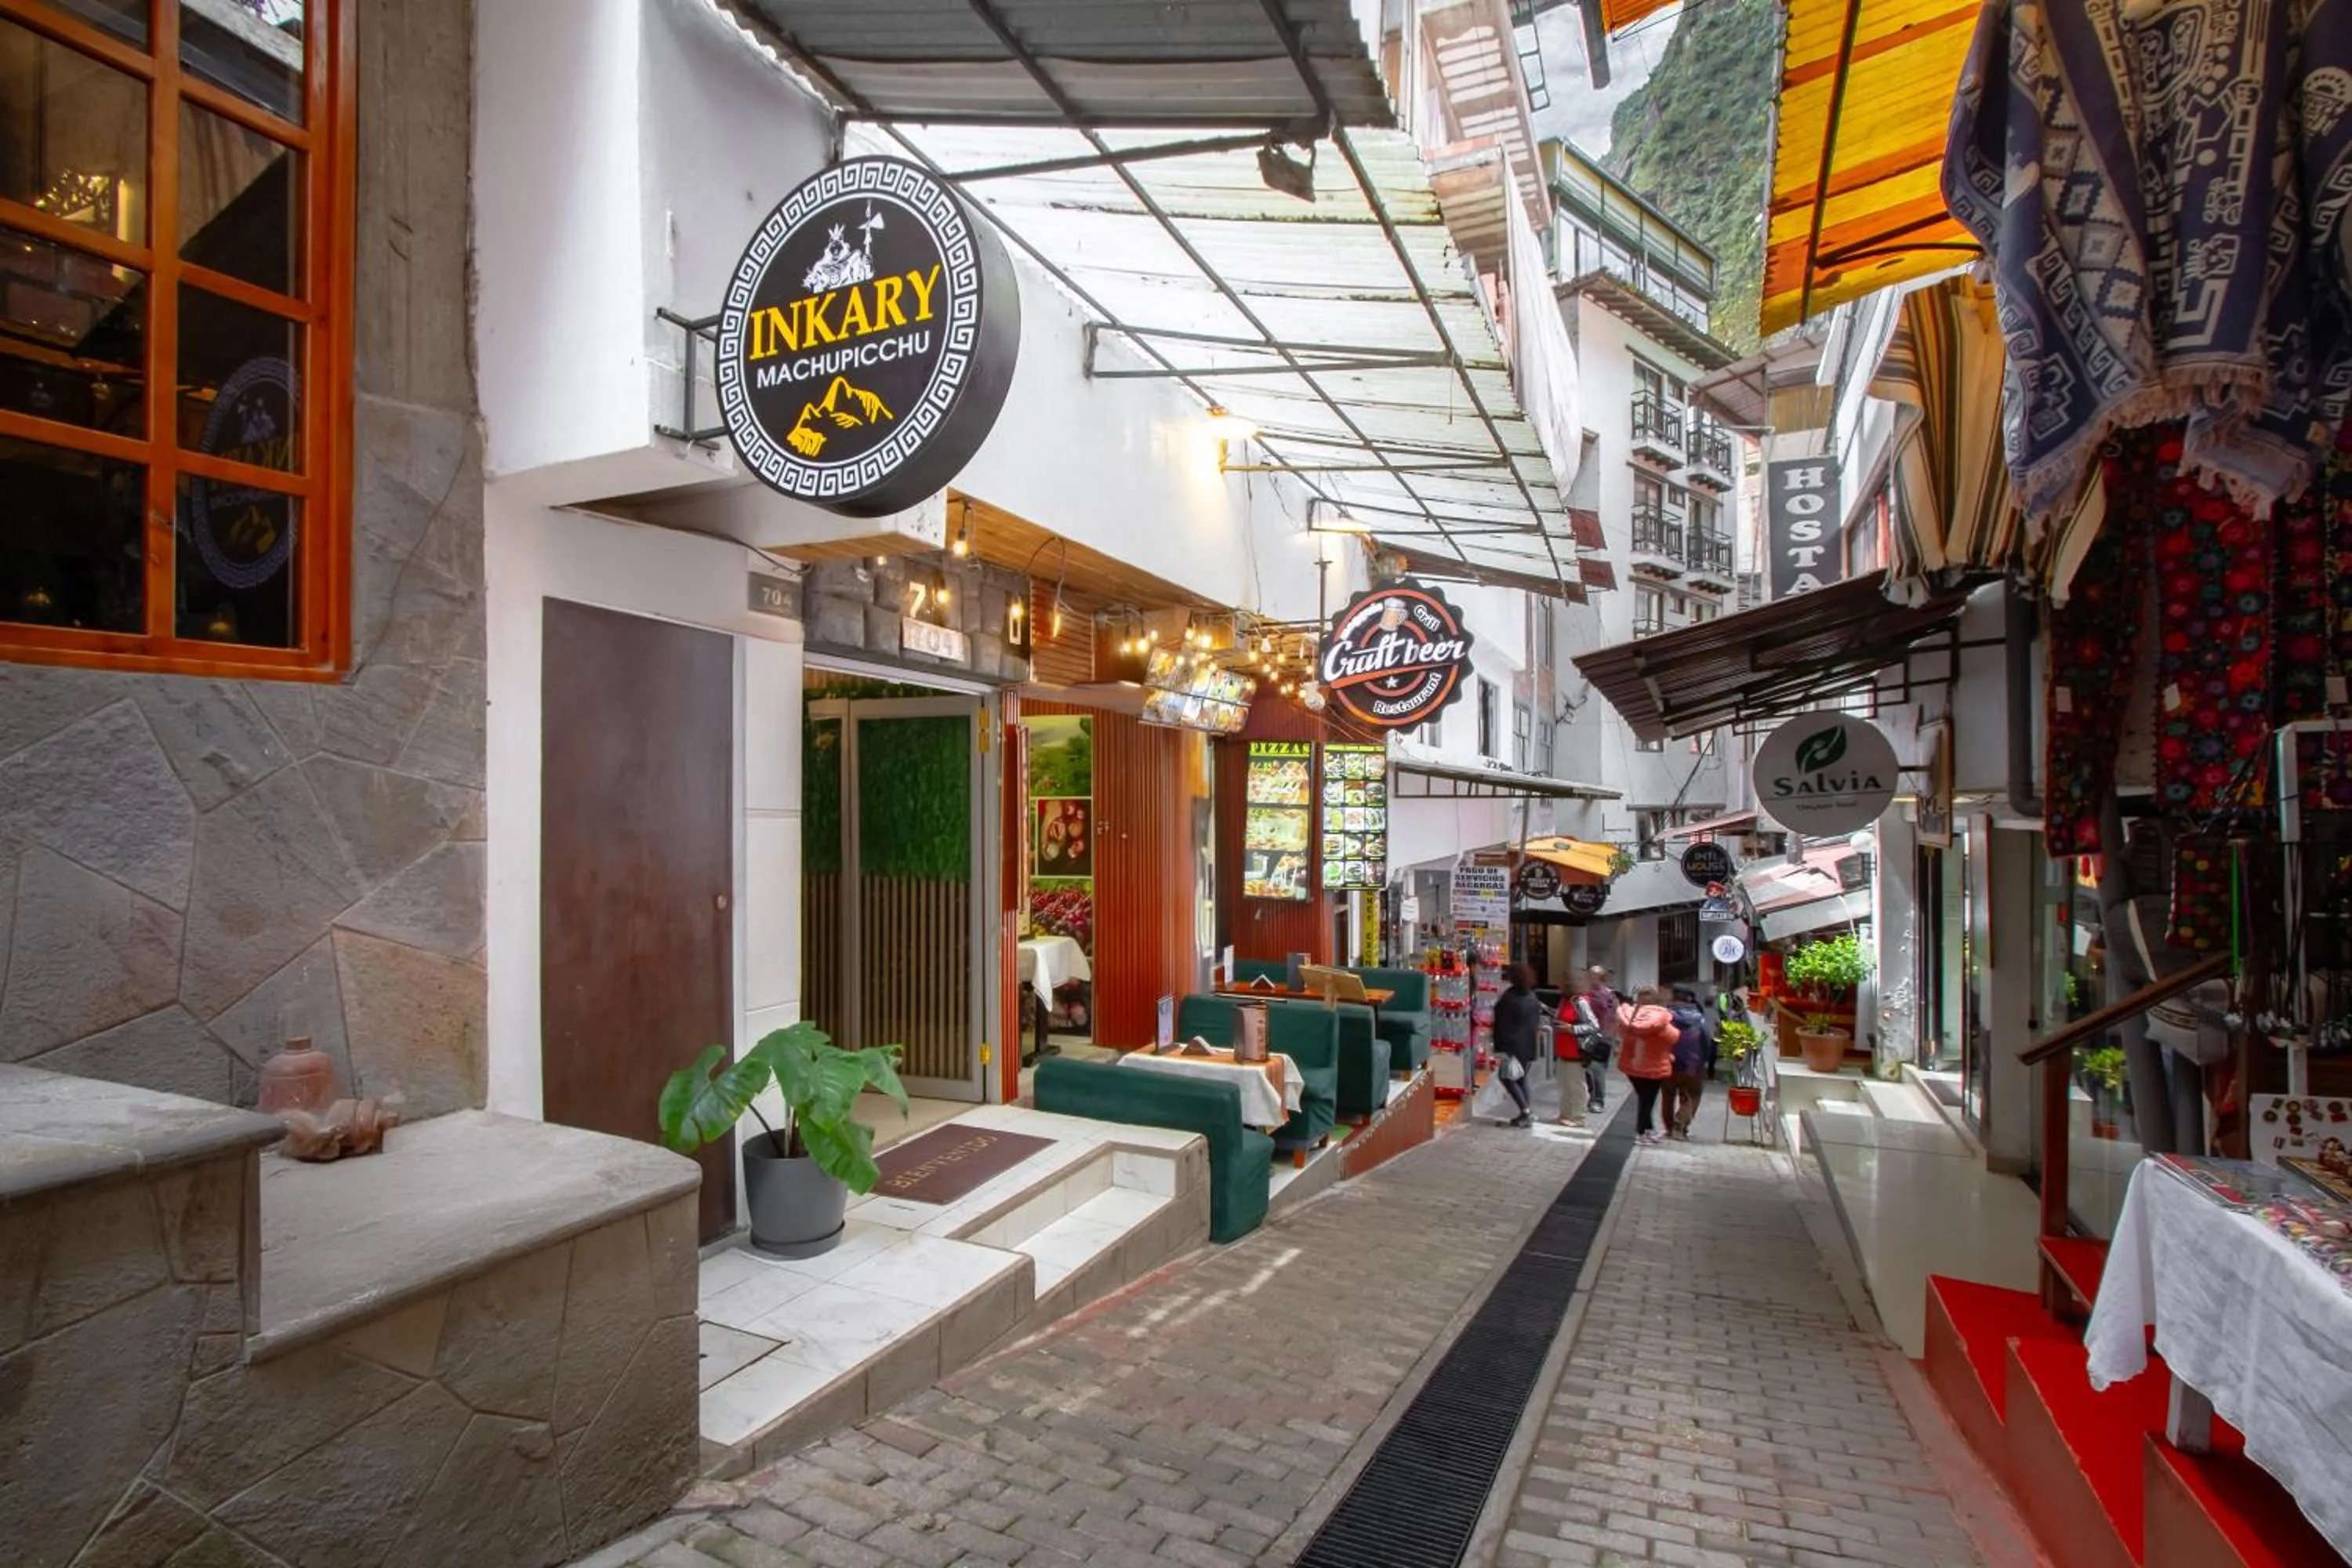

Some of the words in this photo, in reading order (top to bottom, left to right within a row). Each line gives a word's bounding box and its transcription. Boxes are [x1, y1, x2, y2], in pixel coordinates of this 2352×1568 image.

[749, 264, 941, 360] INKARY
[757, 330, 931, 389] MACHUPICCHU
[1784, 466, 1825, 594] HOSTA
[1414, 604, 1441, 632] Grill
[1323, 632, 1406, 681] Craft
[1403, 638, 1465, 665] beer
[1373, 672, 1443, 715] Restaurant
[1250, 742, 1310, 753] PIZZAS
